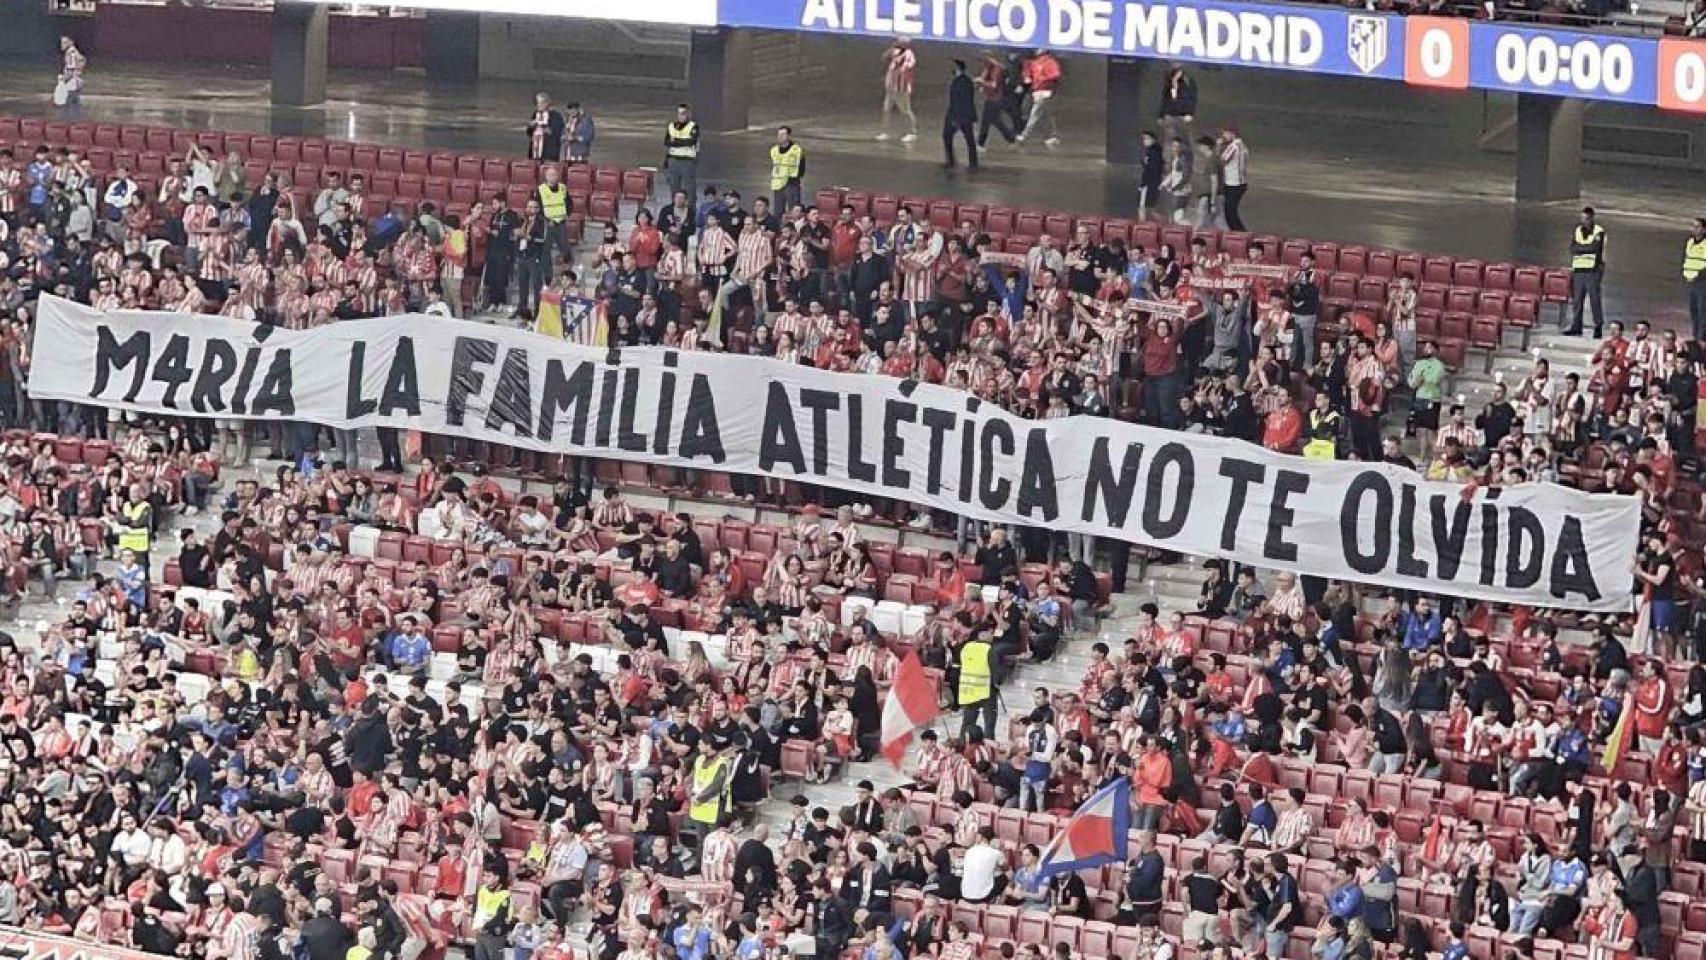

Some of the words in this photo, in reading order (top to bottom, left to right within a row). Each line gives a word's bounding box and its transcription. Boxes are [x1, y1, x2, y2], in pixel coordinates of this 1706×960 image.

[1047, 2, 1112, 49] DE
[1122, 8, 1323, 66] MADRID
[1420, 28, 1452, 78] 0
[1495, 33, 1634, 95] 00:00
[1674, 52, 1706, 103] 0
[91, 324, 297, 416] M4RÍA
[346, 336, 421, 420] LA
[1081, 435, 1194, 539] NO
[1218, 456, 1310, 562] TE
